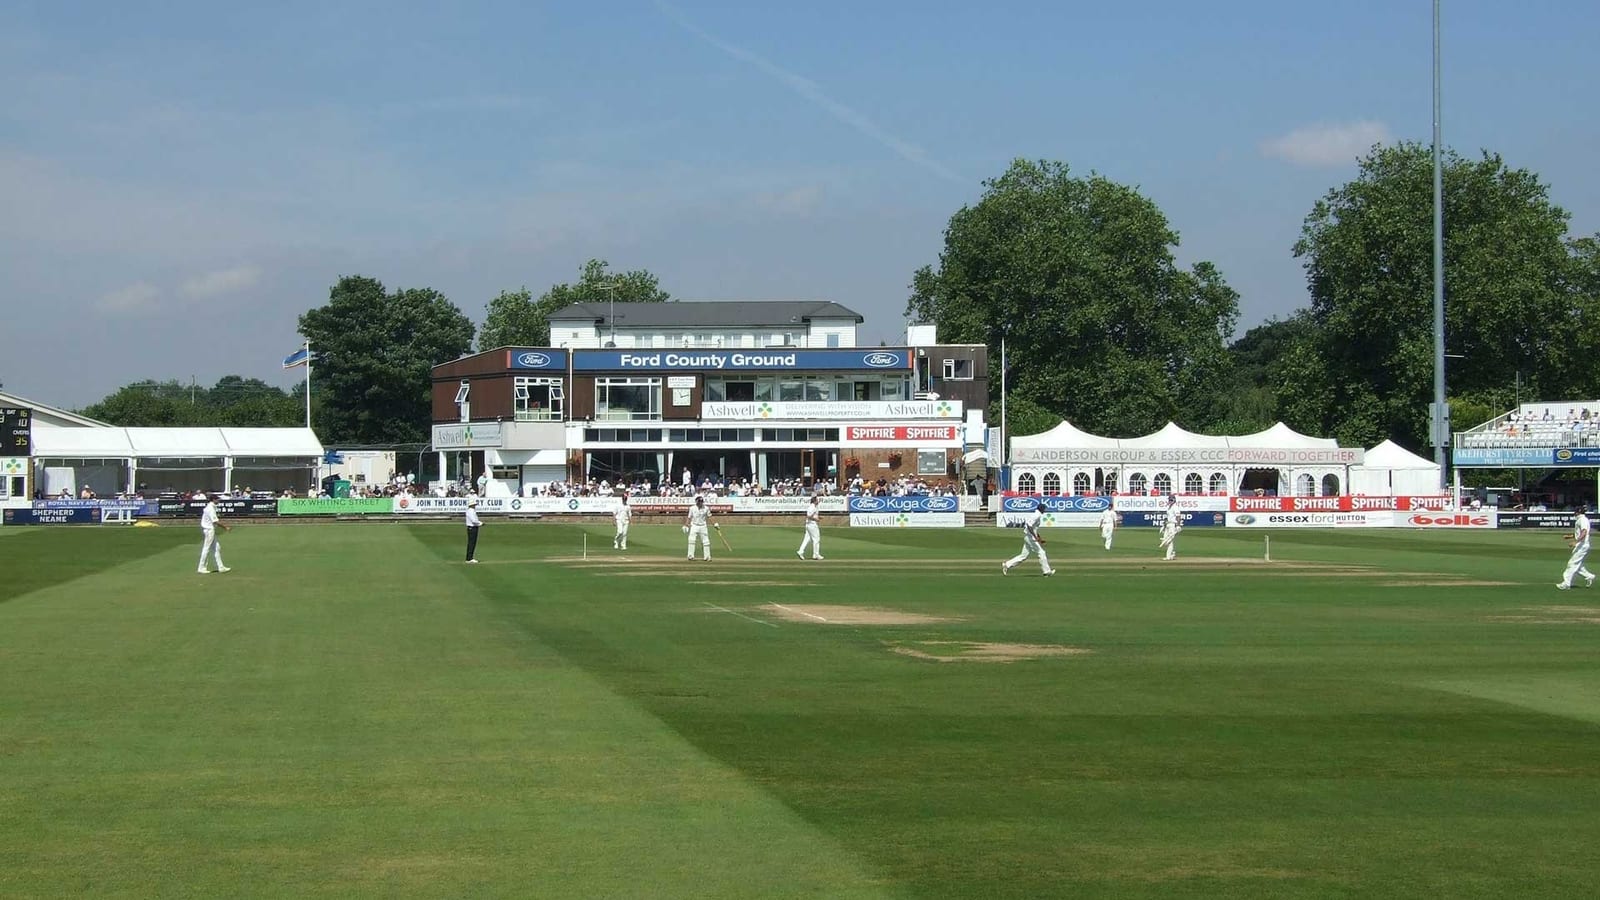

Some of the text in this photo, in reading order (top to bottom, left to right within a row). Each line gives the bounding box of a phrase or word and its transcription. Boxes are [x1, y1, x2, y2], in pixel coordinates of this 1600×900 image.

[621, 354, 795, 368] Ford County Ground
[707, 402, 755, 417] Ashwell
[884, 402, 934, 416] Ashwell
[852, 427, 950, 440] SPITFIRE SPITFIRE
[1032, 450, 1354, 461] ANDERSON GROUP & ESSEX CCC FORWARD TOGETHER
[887, 498, 919, 510] Kuga
[1041, 498, 1073, 510] Kuga
[1117, 498, 1157, 508] national
[1235, 498, 1281, 510] SPITFIRE
[1293, 498, 1339, 510] SPITFIRE
[1352, 497, 1397, 509] SPITFIRE
[853, 515, 895, 526] Ashwell
